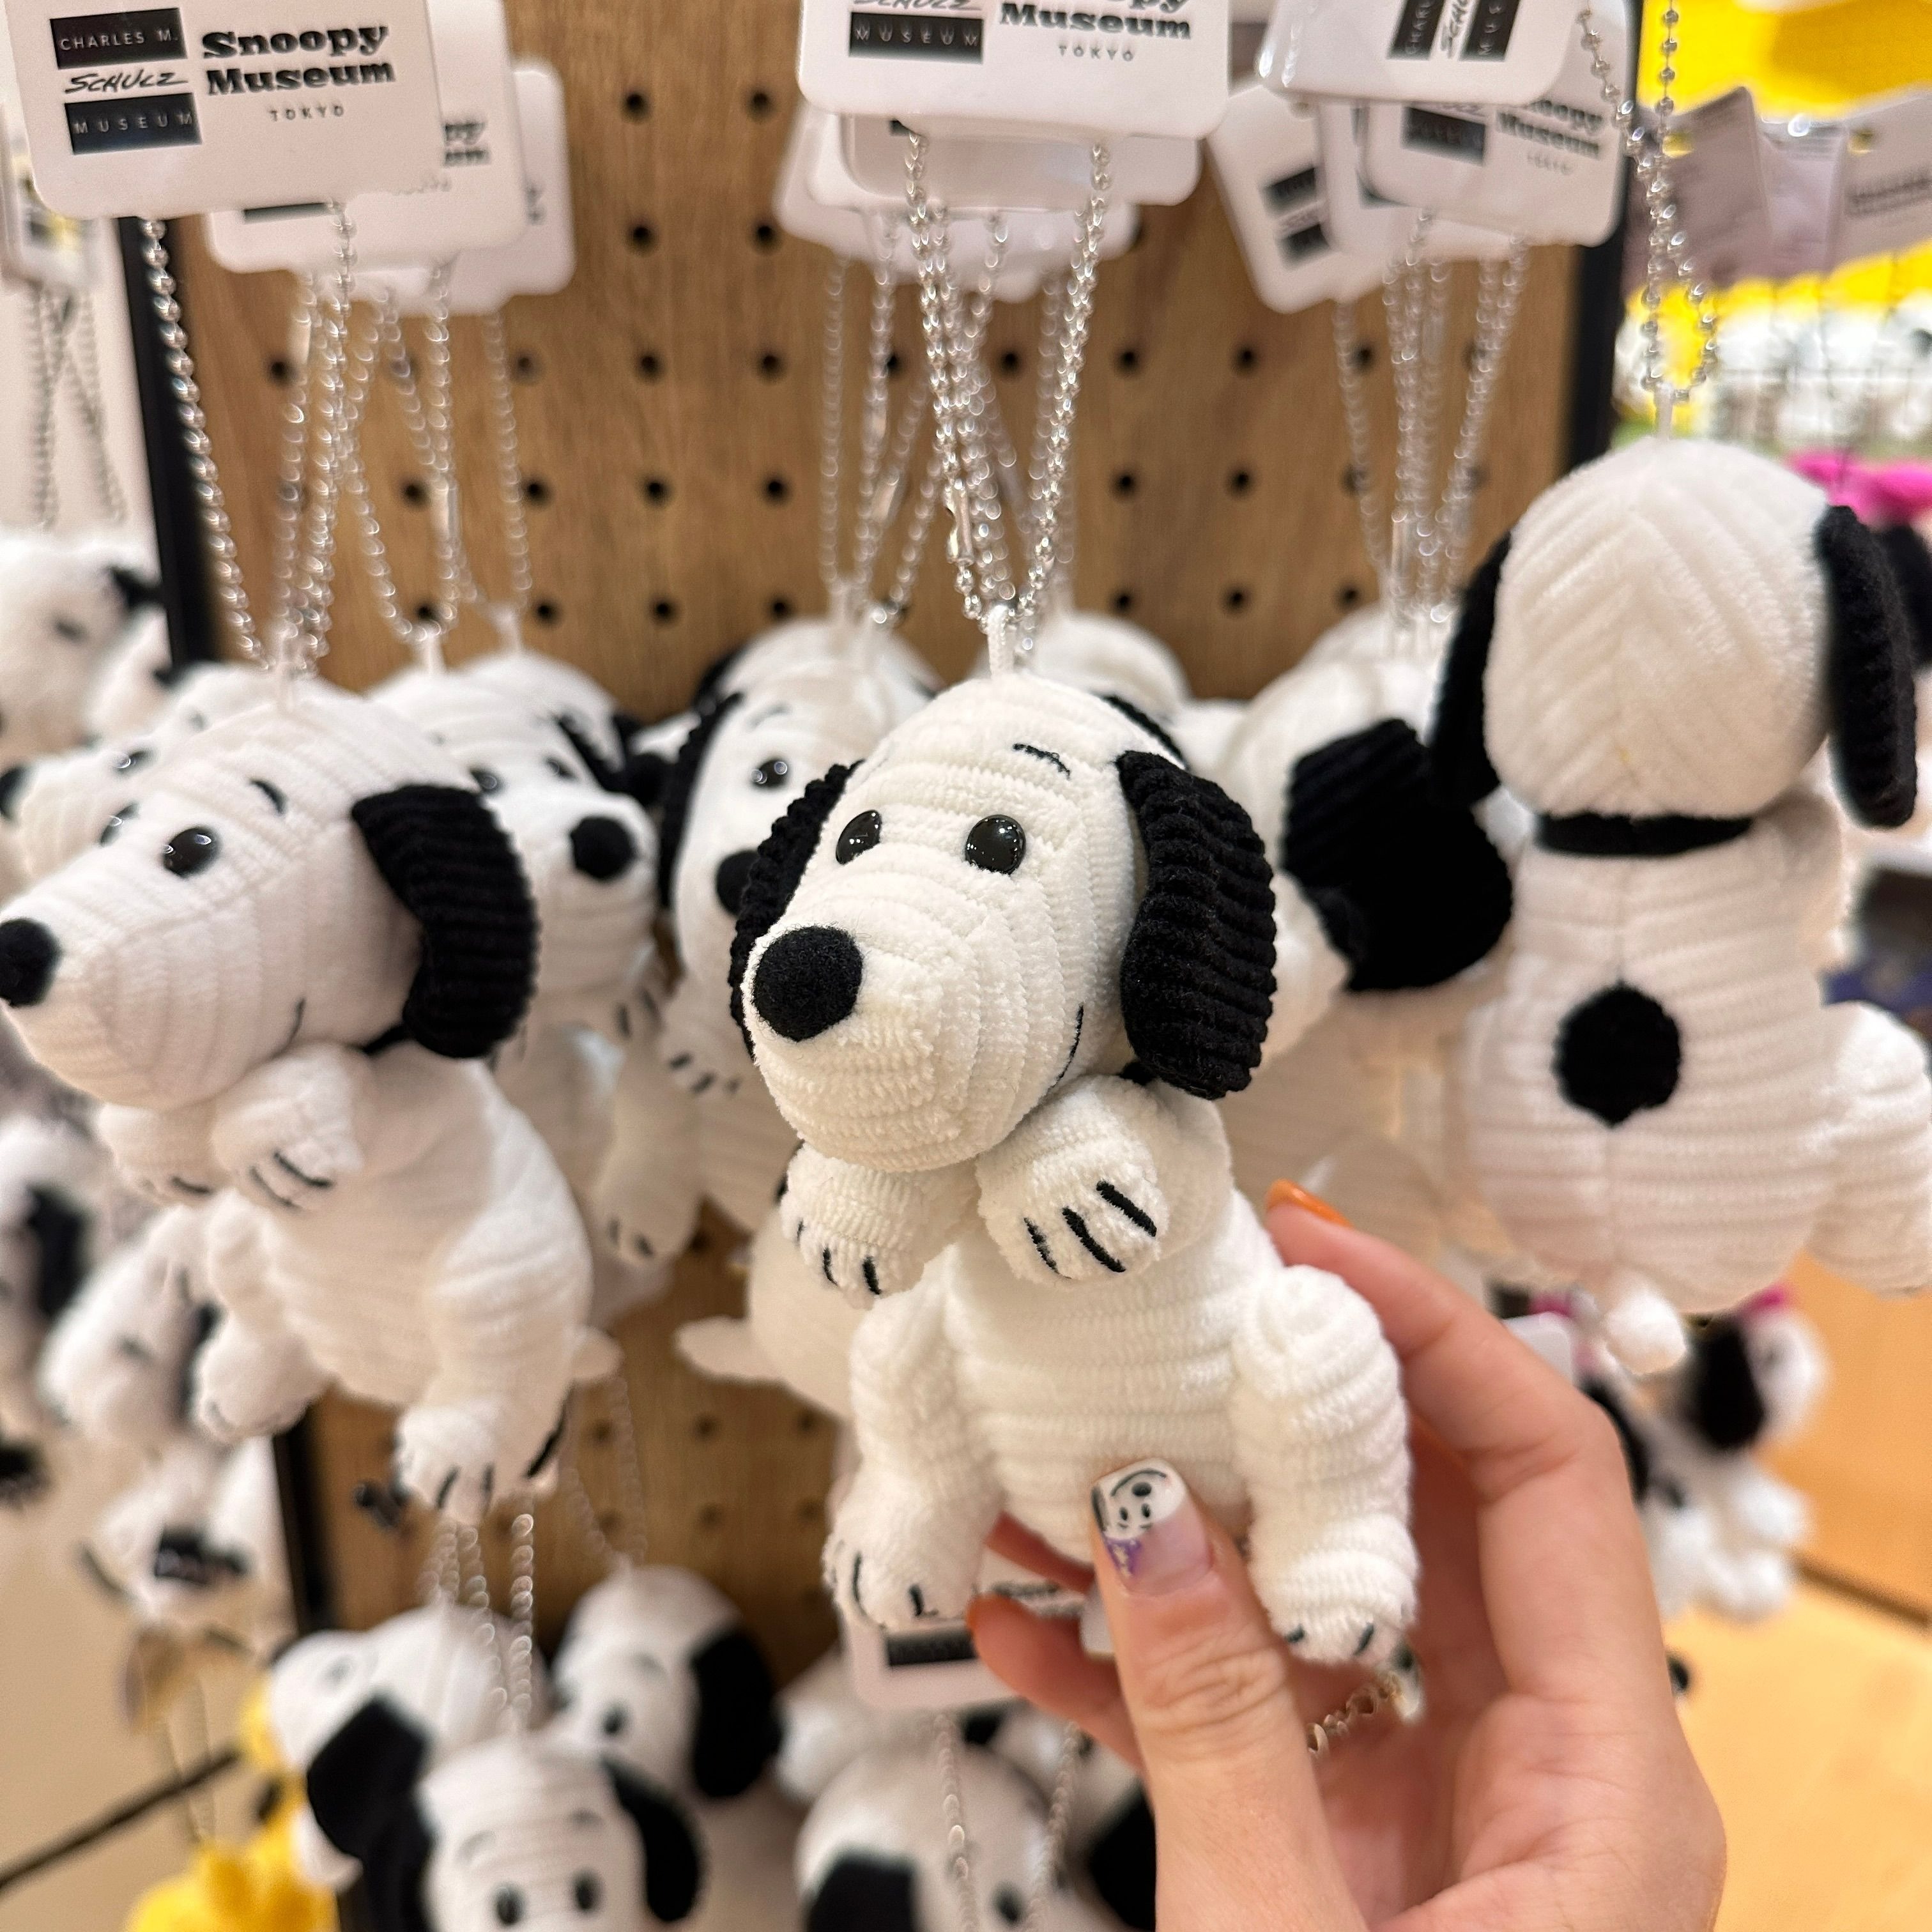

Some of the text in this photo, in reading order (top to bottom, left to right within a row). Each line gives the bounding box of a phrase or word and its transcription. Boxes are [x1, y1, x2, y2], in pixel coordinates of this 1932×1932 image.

[1000, 3, 1192, 40] Museum
[60, 29, 179, 50] CHARLES M.
[202, 26, 390, 59] Snoopy
[854, 26, 978, 47] MUSEUM
[1058, 45, 1134, 62] TOKYO
[64, 68, 189, 95] SCHULZ
[205, 62, 396, 96] Museum
[72, 111, 194, 135] MUSEUM
[269, 104, 345, 122] TOKYO
